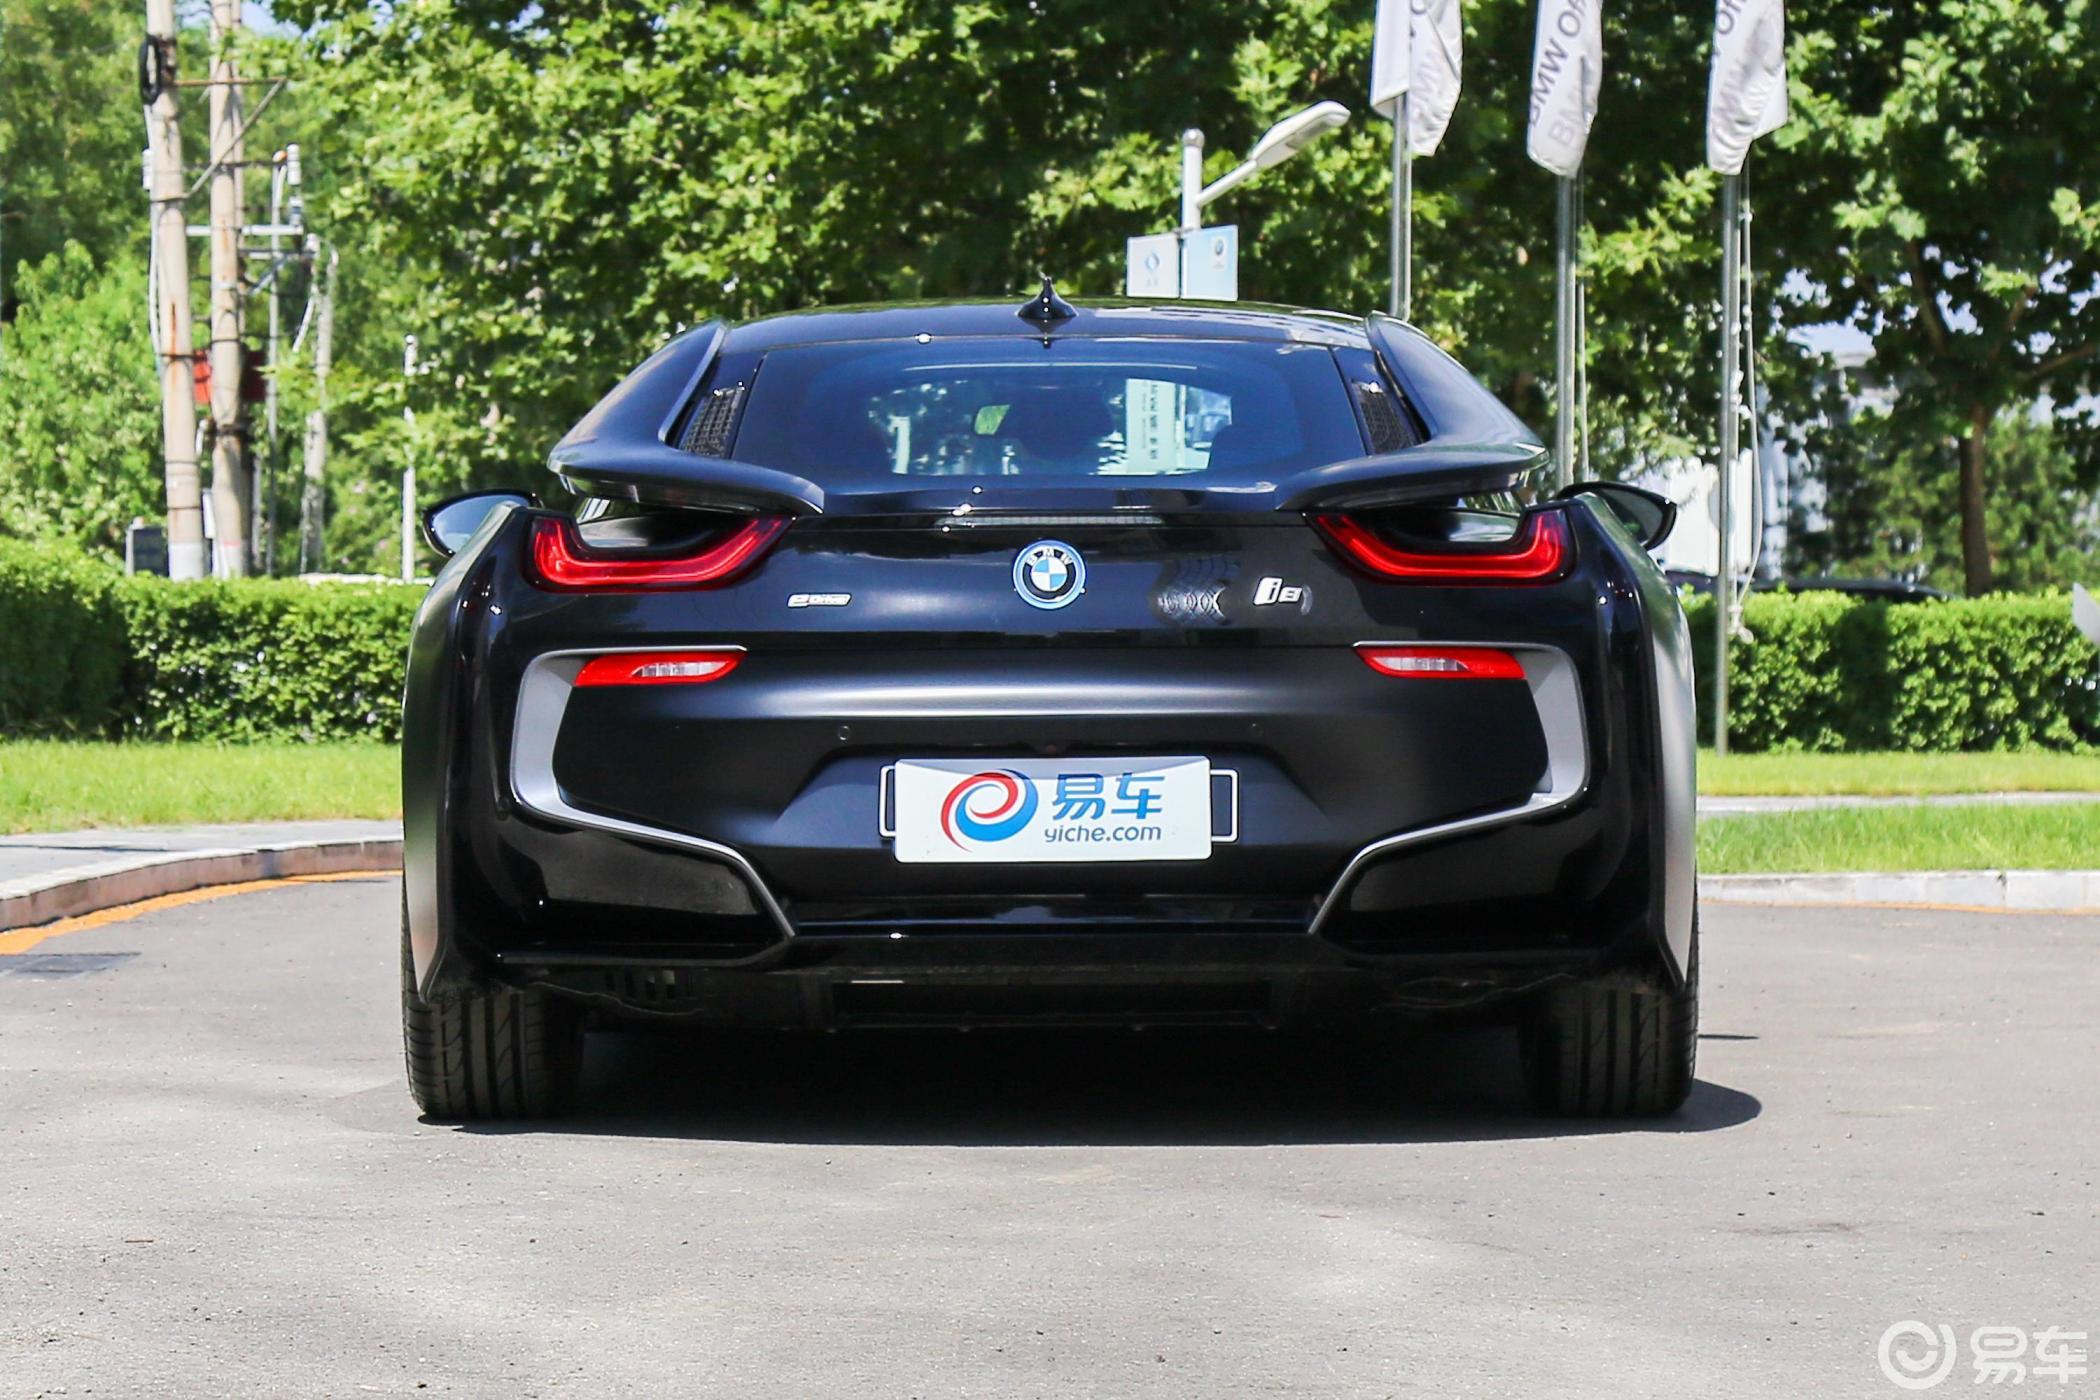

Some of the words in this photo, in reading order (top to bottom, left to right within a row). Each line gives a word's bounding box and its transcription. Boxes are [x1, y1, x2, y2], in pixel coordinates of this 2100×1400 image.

[1025, 547, 1074, 566] BMW
[1253, 577, 1303, 605] i8
[1052, 772, 1165, 820] 易车
[1044, 825, 1162, 843] yiche.com
